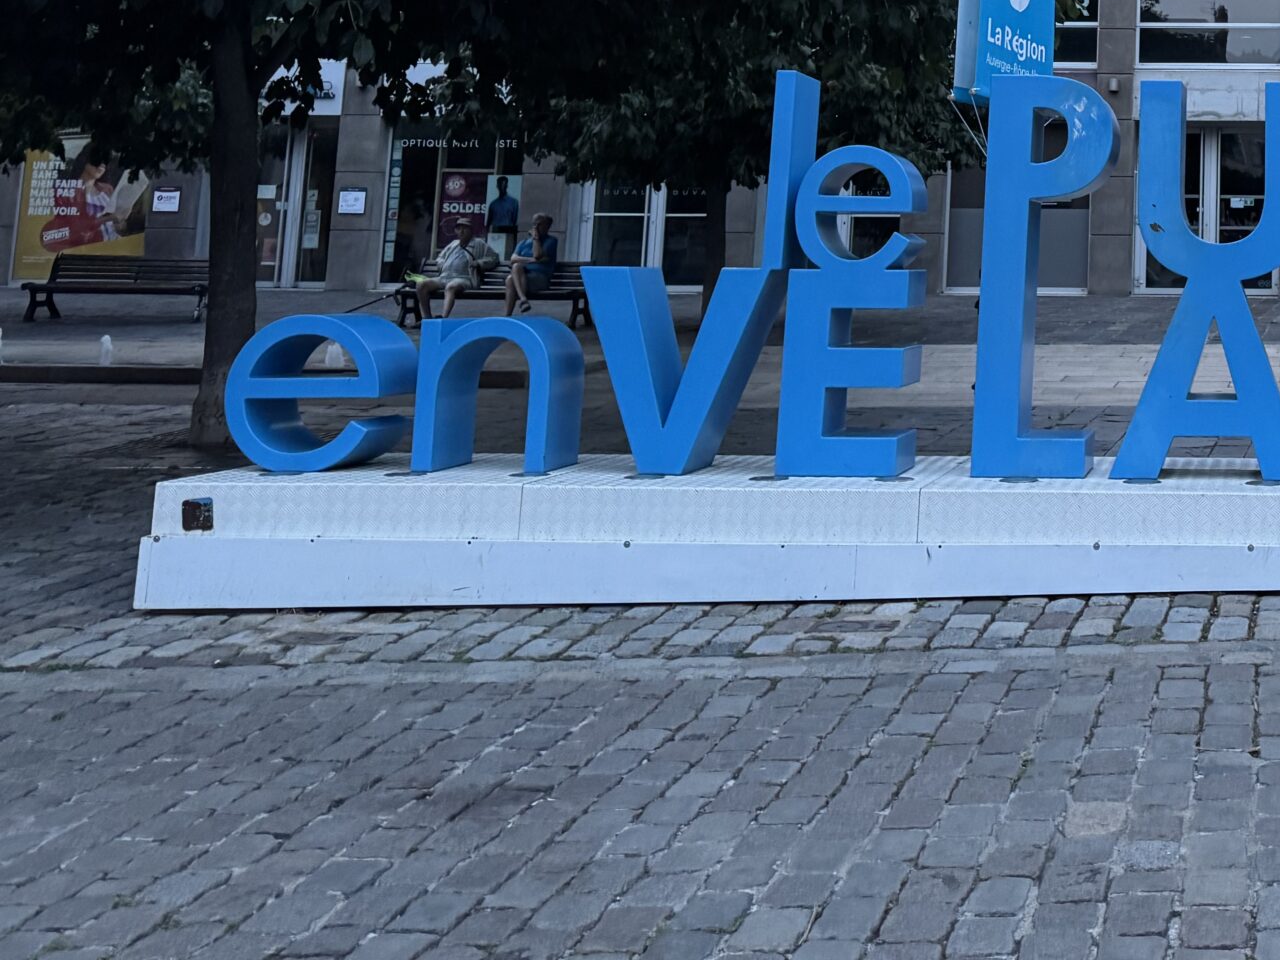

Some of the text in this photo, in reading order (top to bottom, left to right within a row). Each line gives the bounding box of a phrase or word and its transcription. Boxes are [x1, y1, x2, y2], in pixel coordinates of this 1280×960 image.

[987, 17, 1046, 63] La Région
[401, 139, 448, 149] OPTIQUE
[33, 161, 47, 170] UN
[763, 70, 928, 271] le
[32, 170, 58, 179] SANS
[31, 179, 86, 190] RIEN FAIRE,
[30, 188, 76, 198] MAIS PAS
[27, 206, 80, 216] RIEN VOIR.
[443, 202, 487, 214] SOLDES
[224, 313, 584, 473] en
